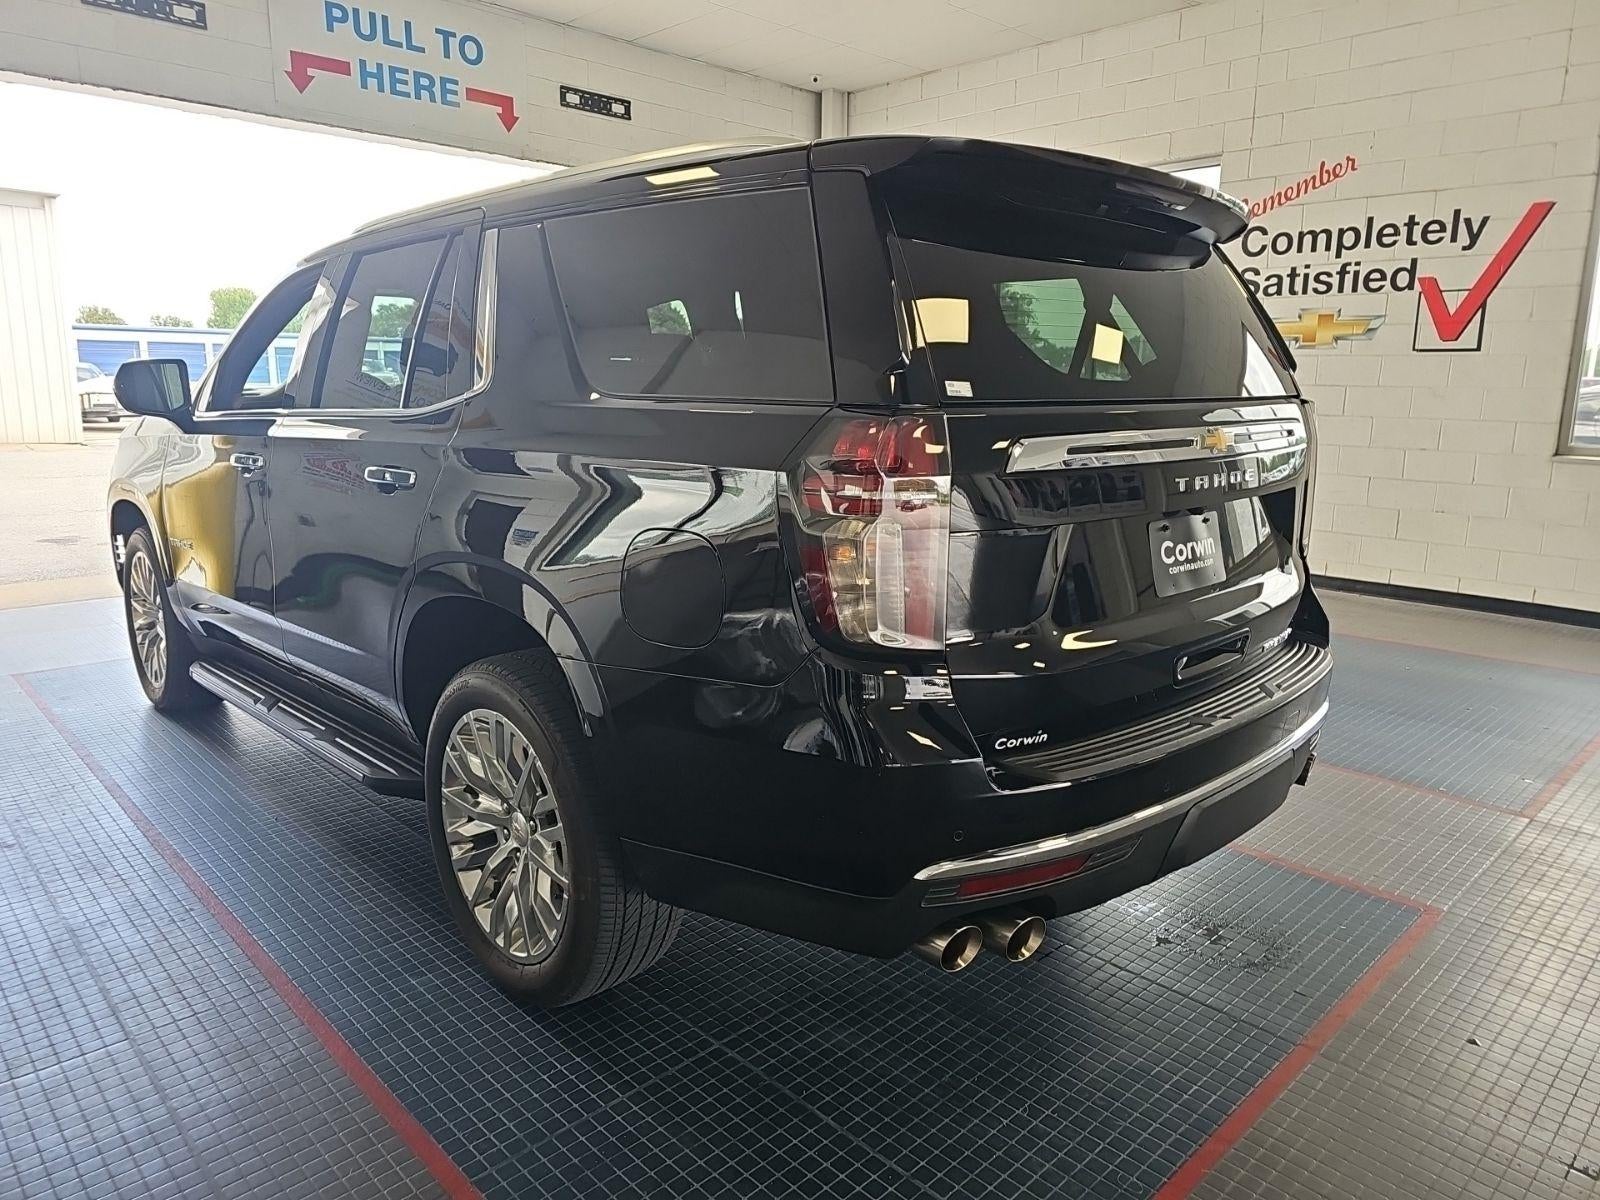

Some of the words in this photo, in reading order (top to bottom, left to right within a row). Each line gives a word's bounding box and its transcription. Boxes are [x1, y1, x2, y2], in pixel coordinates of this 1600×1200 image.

[324, 0, 426, 54] PULL
[434, 27, 484, 66] TO
[358, 58, 461, 108] HERE
[1240, 208, 1491, 259] Completely
[1240, 257, 1418, 297] Satisfied
[1174, 468, 1255, 492] TAHOE
[1160, 537, 1216, 565] Corwin
[1168, 558, 1214, 575] corwinauto.com
[994, 729, 1048, 750] Corwin
